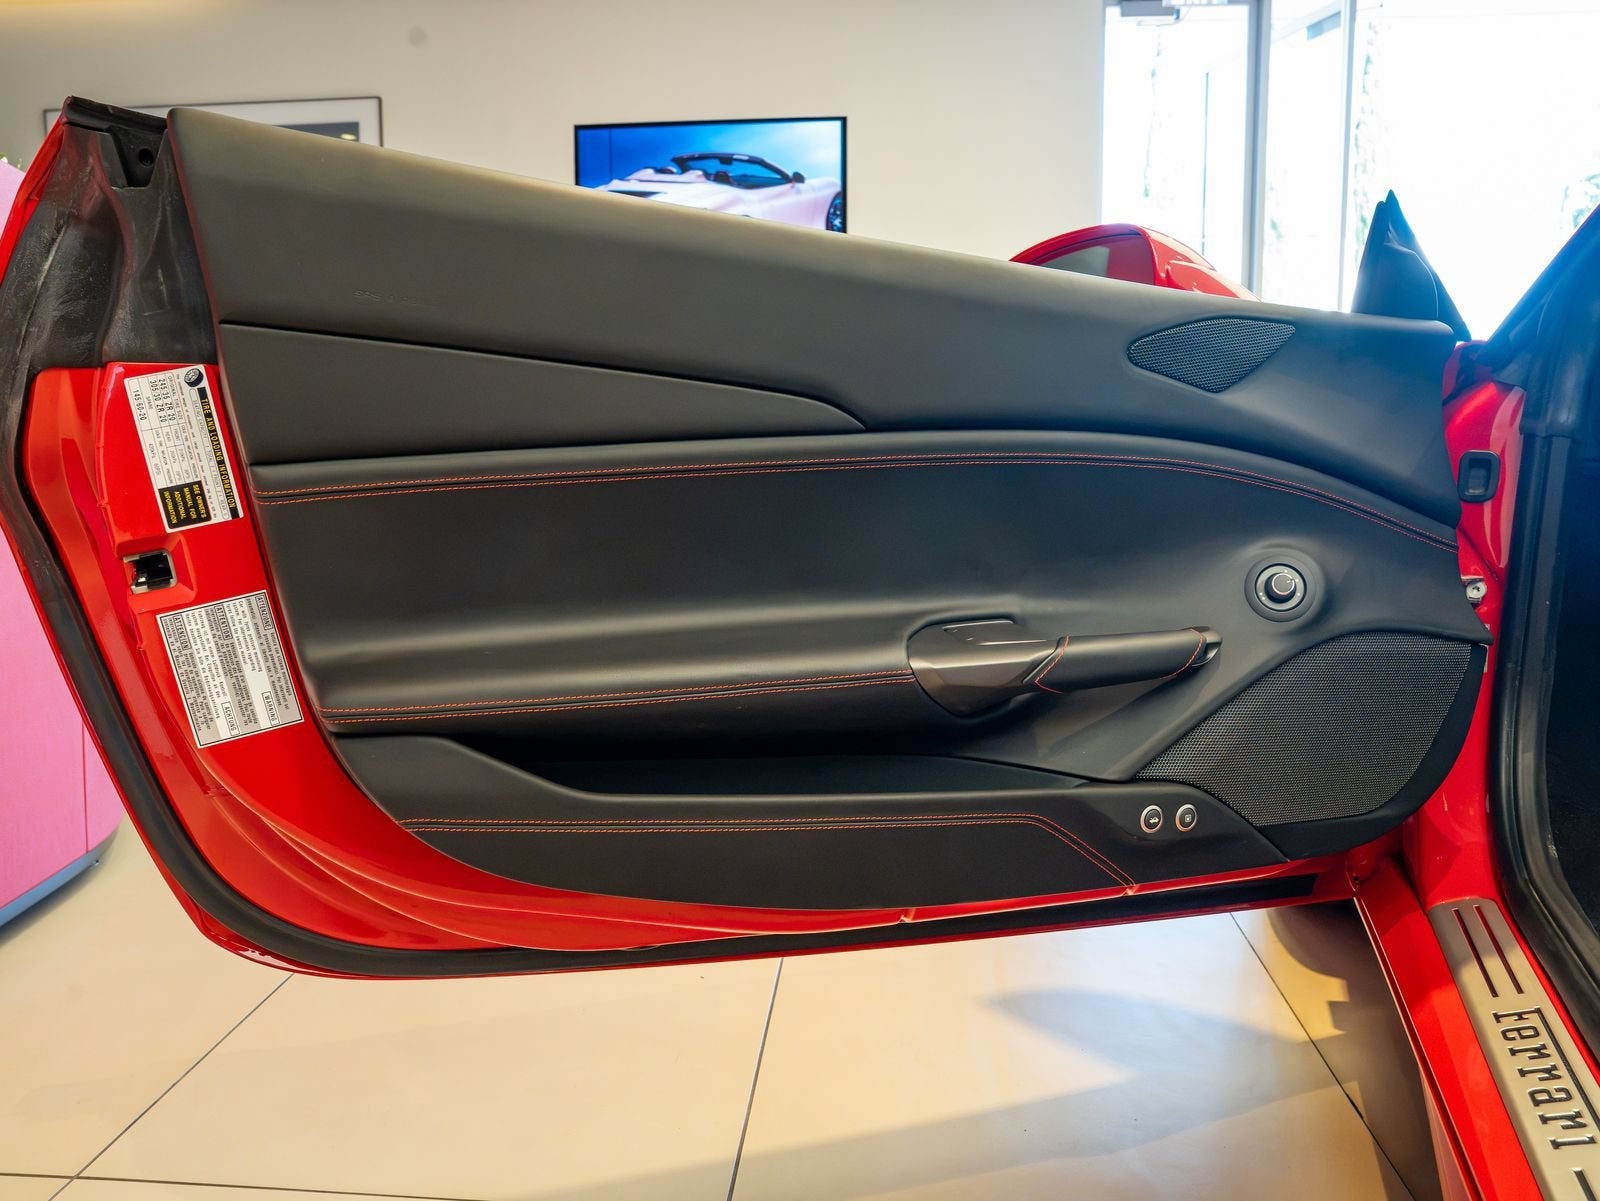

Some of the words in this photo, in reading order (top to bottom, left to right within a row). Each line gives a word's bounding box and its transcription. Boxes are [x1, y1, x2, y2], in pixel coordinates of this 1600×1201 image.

[201, 399, 211, 414] TIRE
[206, 417, 216, 431] AND
[209, 432, 223, 461] LOADING
[218, 464, 236, 508] INFORMATION
[163, 490, 178, 524] INFORMATION
[173, 490, 187, 520] ADDITIONAL
[183, 487, 194, 507] MANUAL
[189, 508, 197, 519] FOR
[216, 607, 231, 639] ATTENTION
[257, 597, 272, 628] ATTENZIONE
[224, 705, 238, 732] ACHTUNG
[264, 695, 277, 722] WARNING
[1492, 1006, 1598, 1150] Ferrari
